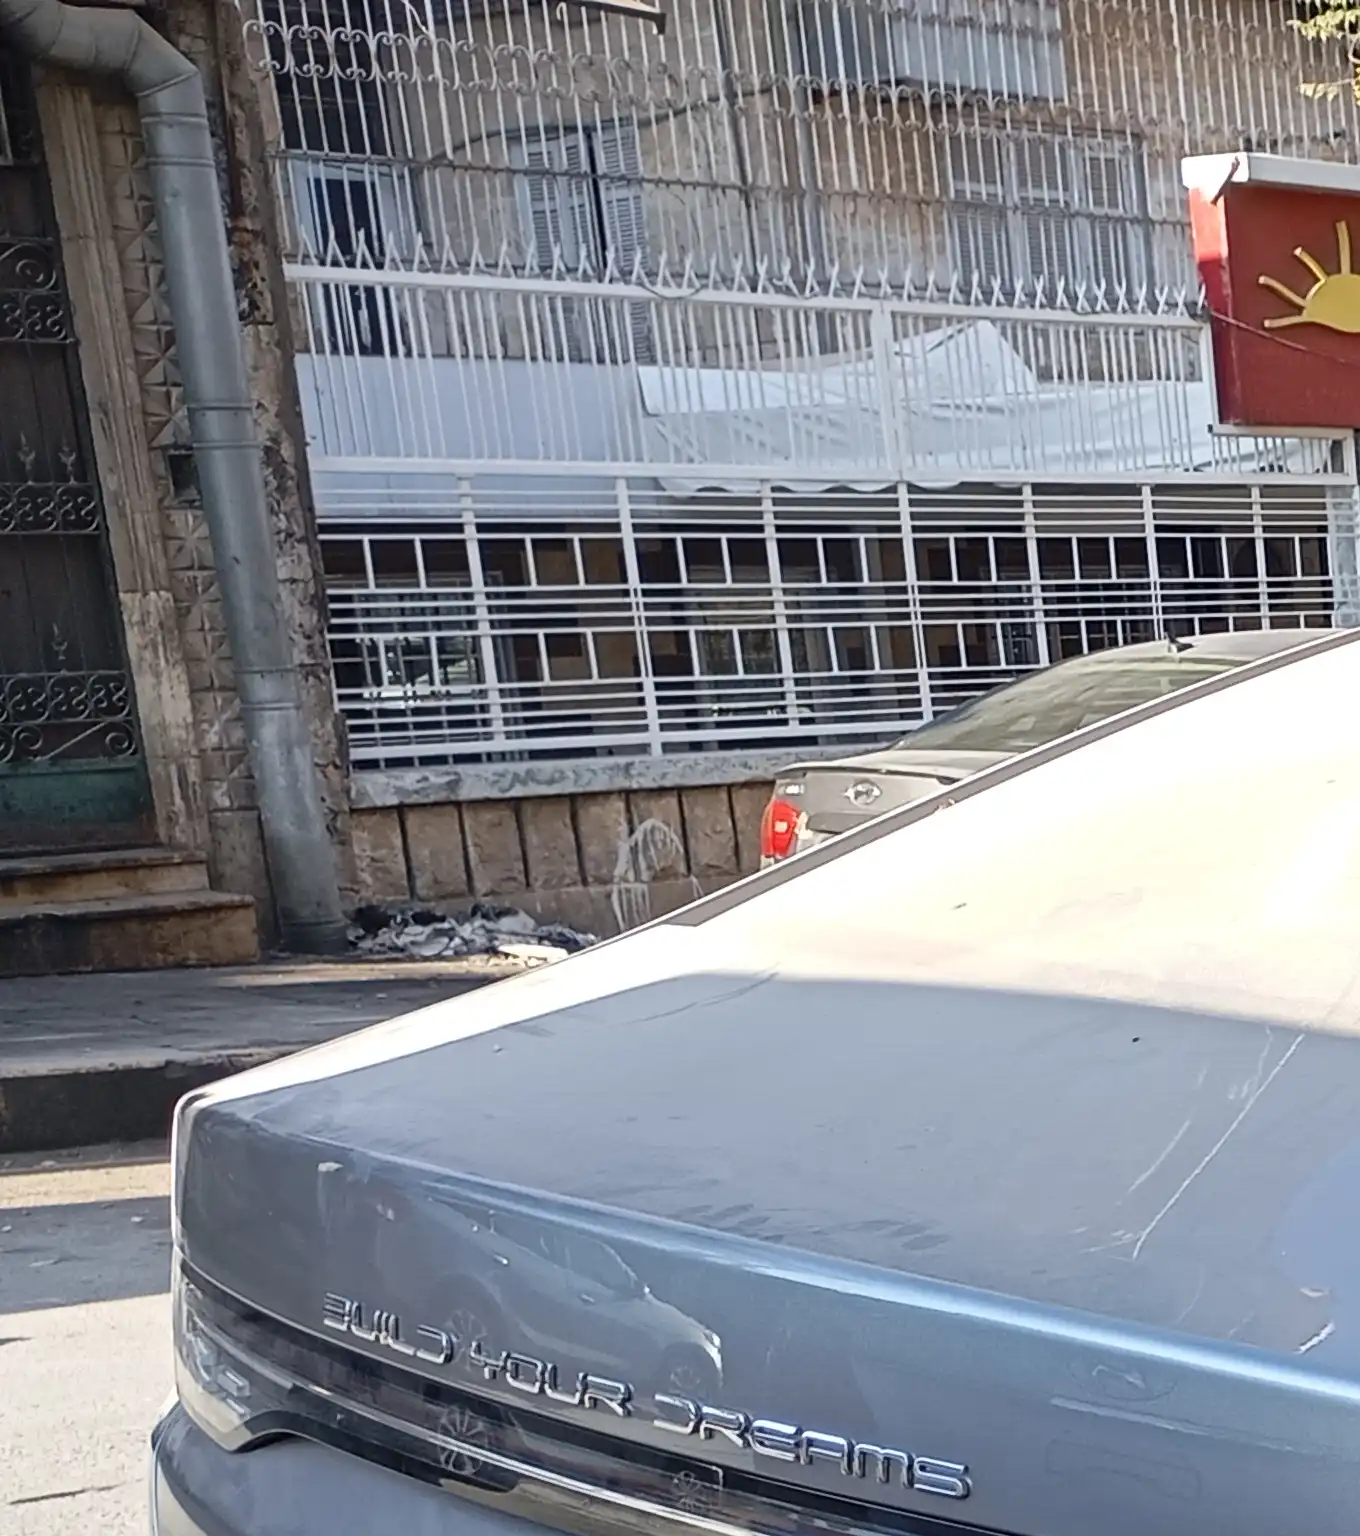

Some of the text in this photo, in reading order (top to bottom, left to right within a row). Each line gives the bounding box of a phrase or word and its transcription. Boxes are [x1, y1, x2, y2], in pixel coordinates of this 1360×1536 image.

[322, 1291, 973, 1500] BUILD YOUR DREAMS
